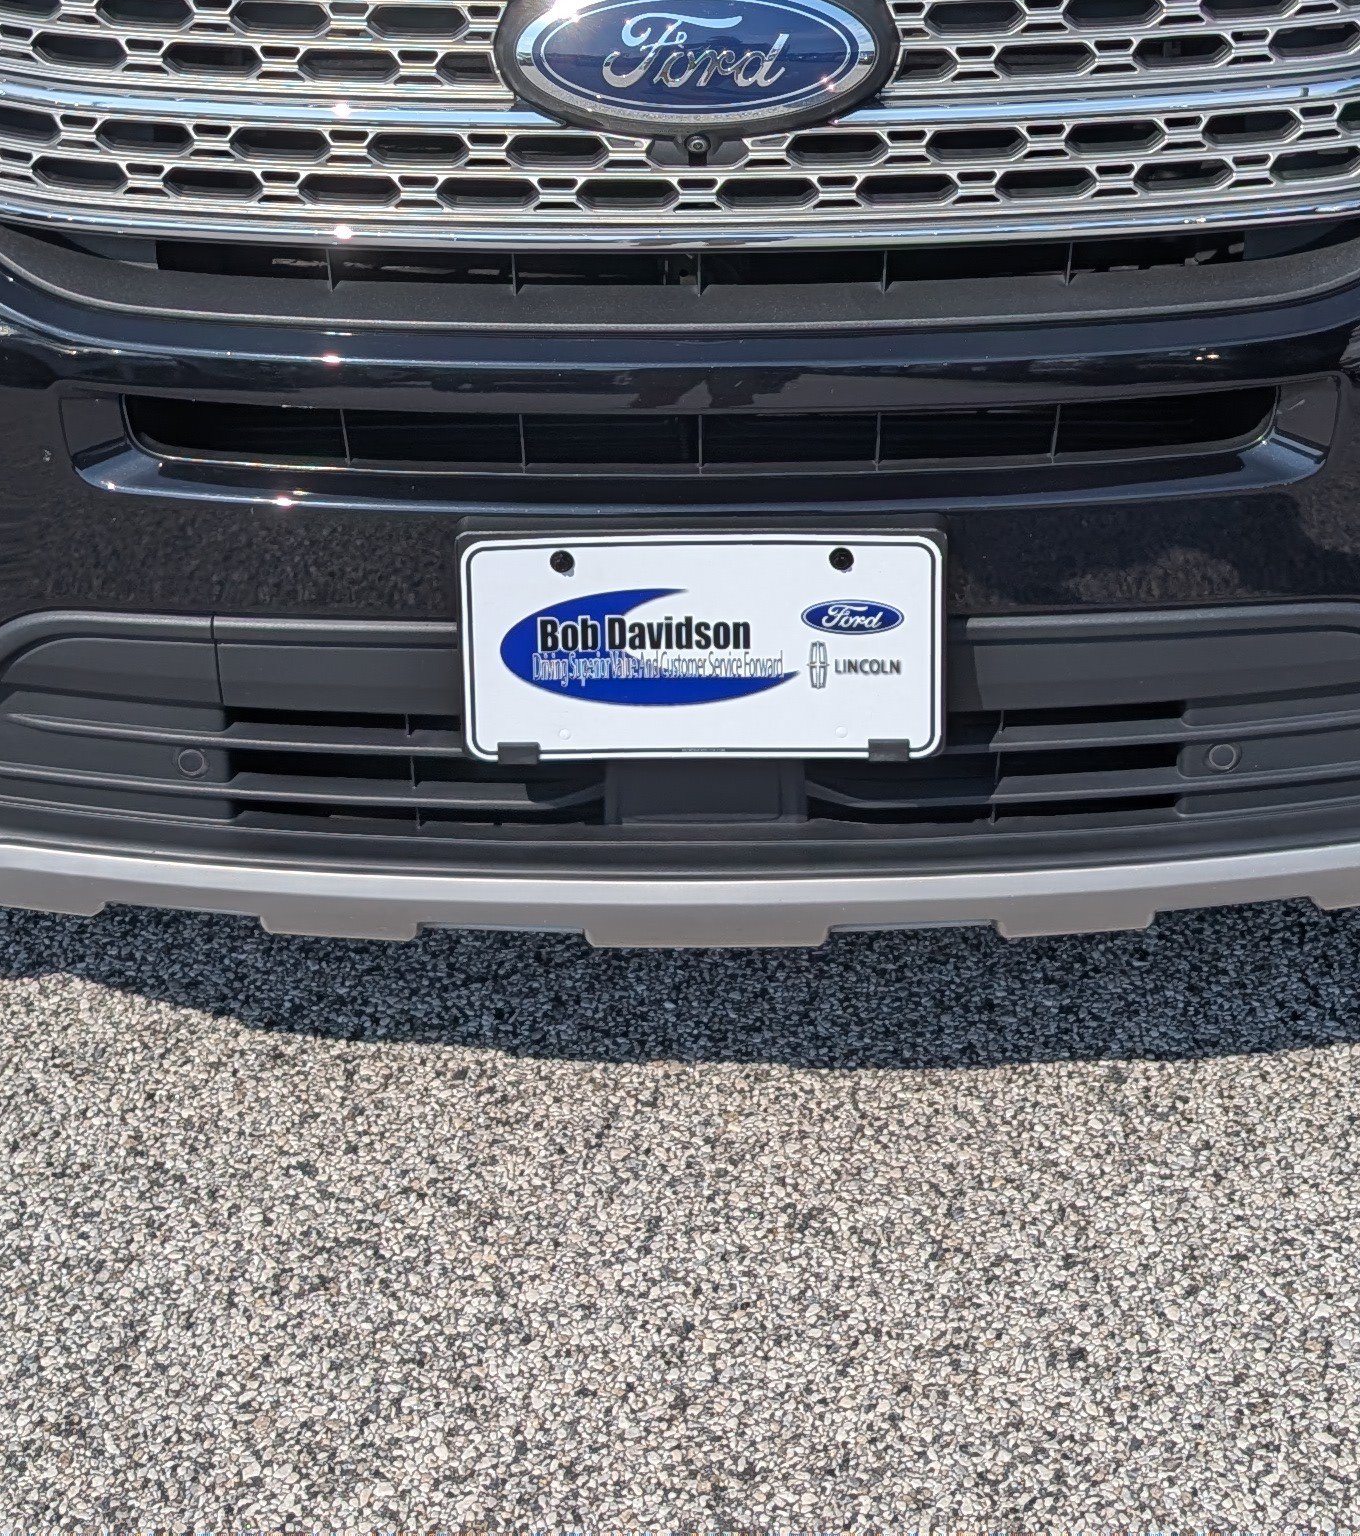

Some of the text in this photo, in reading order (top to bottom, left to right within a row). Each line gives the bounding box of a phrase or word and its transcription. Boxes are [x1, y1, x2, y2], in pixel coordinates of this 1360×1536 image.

[602, 11, 789, 88] Ford
[539, 615, 751, 652] Bob Davidson
[821, 604, 884, 629] Ford
[532, 649, 784, 687] Driving Superior Value And Customer Service Forward
[834, 658, 902, 675] LINCOLN
